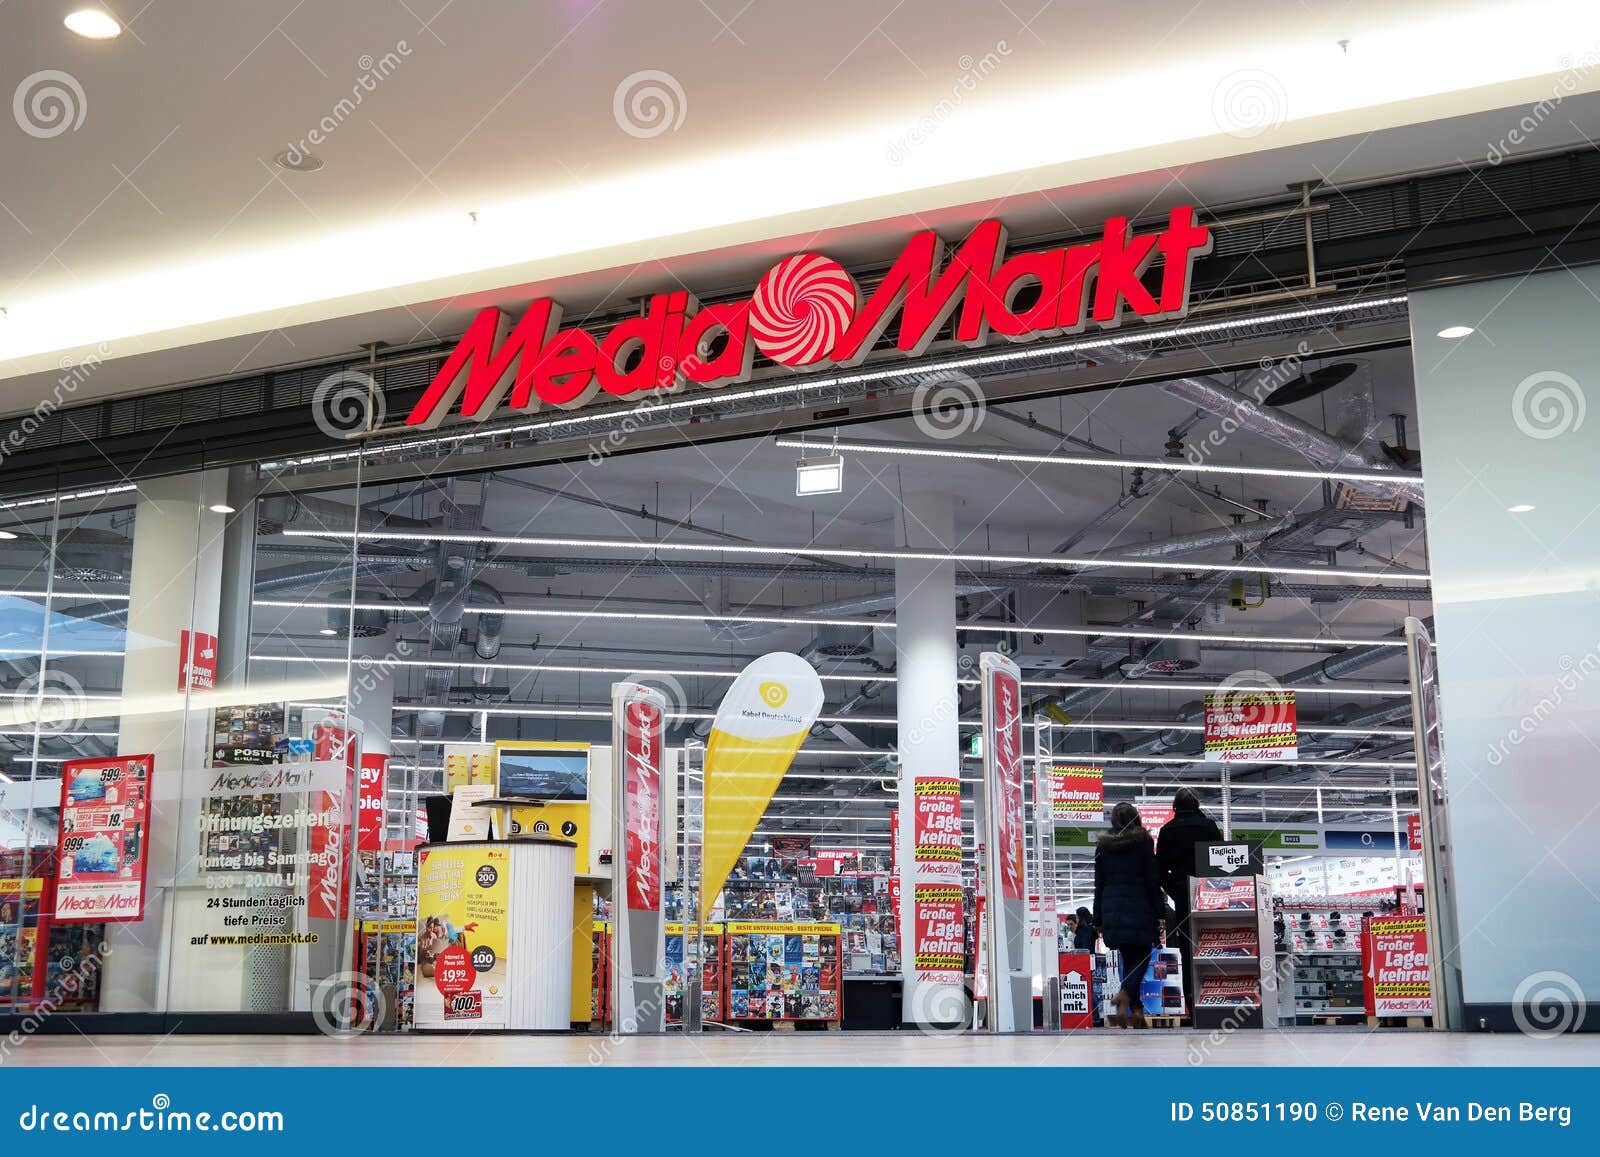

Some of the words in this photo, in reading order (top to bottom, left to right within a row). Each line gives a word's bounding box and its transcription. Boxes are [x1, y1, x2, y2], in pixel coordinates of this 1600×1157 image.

[406, 290, 753, 426] Media
[830, 203, 1210, 363] Markt
[1206, 712, 1245, 723] Großer
[1206, 721, 1293, 738] Lagerkehraus
[1219, 751, 1248, 761] Media
[1255, 749, 1282, 759] Markt
[211, 772, 258, 791] Media
[919, 801, 955, 813] Großer
[1053, 812, 1068, 820] edia
[1072, 812, 1093, 820] Markt
[926, 812, 961, 833] Lage
[919, 829, 961, 845] kehrau
[244, 851, 265, 866] bis
[268, 850, 327, 867] Samstag
[1210, 848, 1237, 857] Täglich
[636, 818, 652, 910] Media
[1227, 854, 1247, 865] tief.
[917, 863, 948, 874] Media
[478, 873, 495, 882] 200
[58, 895, 96, 912] Media
[104, 893, 138, 910] Markt
[207, 898, 220, 909] 24
[222, 897, 265, 908] Stunden
[268, 896, 305, 909] täglich
[919, 908, 955, 920] Großer
[224, 915, 249, 926] tiefe
[252, 915, 286, 926] Preise
[926, 920, 963, 940] Lage
[191, 934, 208, 945] auf
[210, 932, 319, 945] www.mediamarkt.de
[1377, 940, 1415, 951] Großer
[473, 953, 493, 963] 100
[1379, 968, 1430, 982] kehrau
[1063, 982, 1086, 990] Nimm
[1063, 991, 1086, 999] mich
[1063, 1000, 1087, 1012] mit.
[1378, 1000, 1409, 1010] Media
